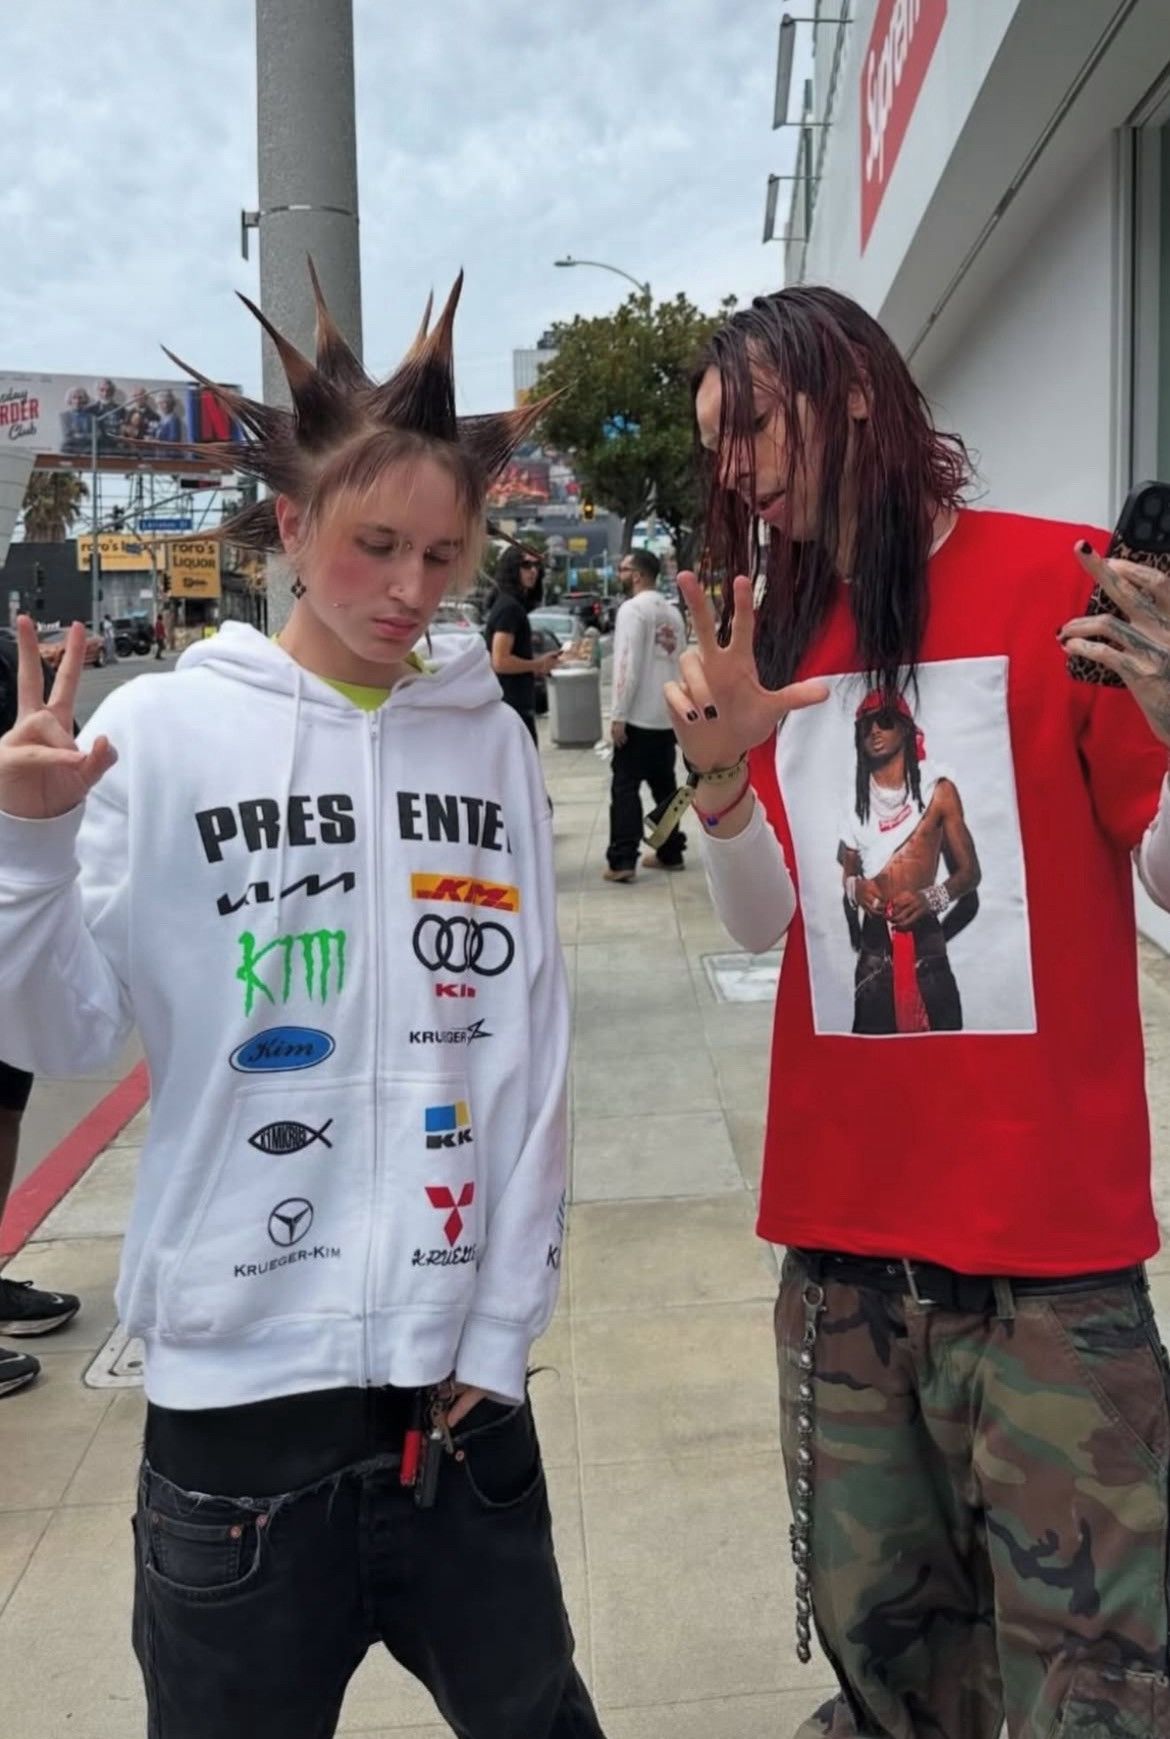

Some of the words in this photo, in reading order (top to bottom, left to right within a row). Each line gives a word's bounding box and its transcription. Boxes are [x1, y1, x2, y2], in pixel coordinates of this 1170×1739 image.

[8, 421, 37, 441] Club
[195, 794, 356, 864] PRES
[396, 791, 512, 855] ENTE
[247, 1037, 315, 1063] Kim
